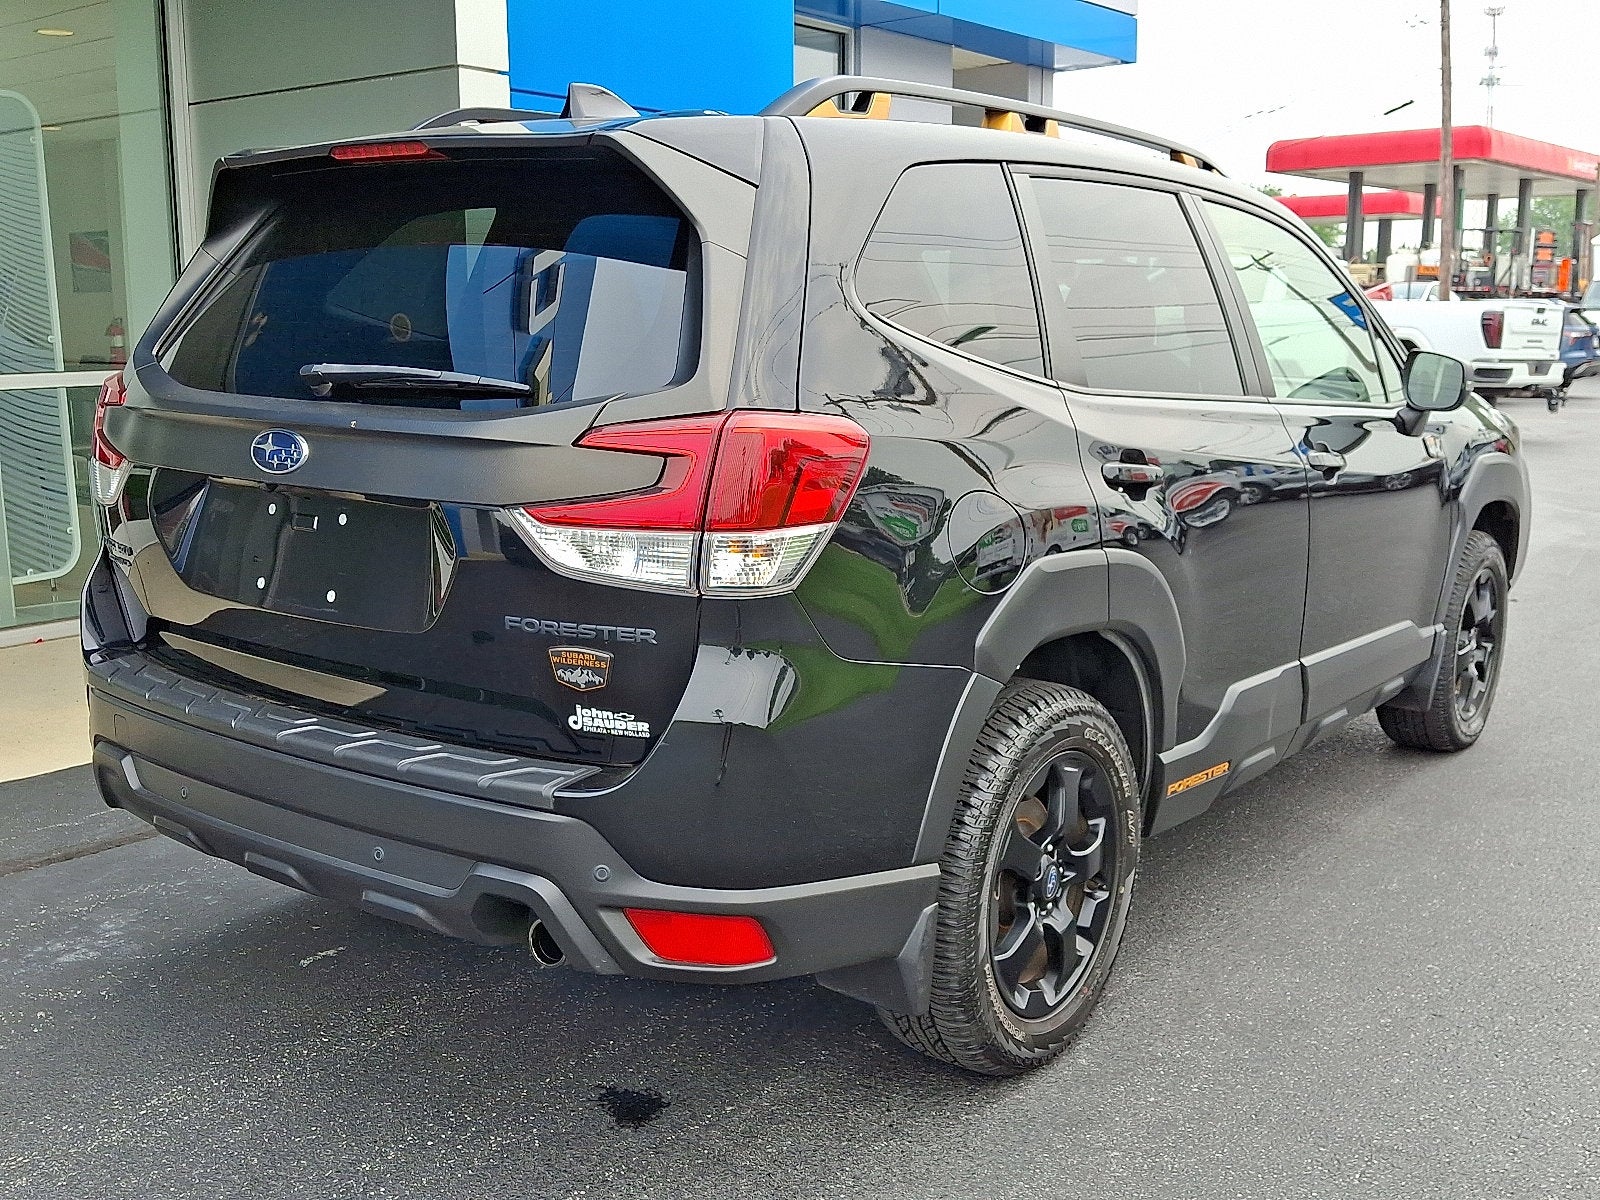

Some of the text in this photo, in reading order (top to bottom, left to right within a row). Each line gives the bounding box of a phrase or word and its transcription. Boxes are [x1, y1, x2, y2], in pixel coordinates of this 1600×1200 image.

[504, 615, 658, 645] FORESTER
[552, 656, 607, 668] WILDERNESS
[561, 652, 596, 661] SUBARU
[583, 716, 650, 732] SAUDER
[1167, 761, 1230, 797] FORESTER
